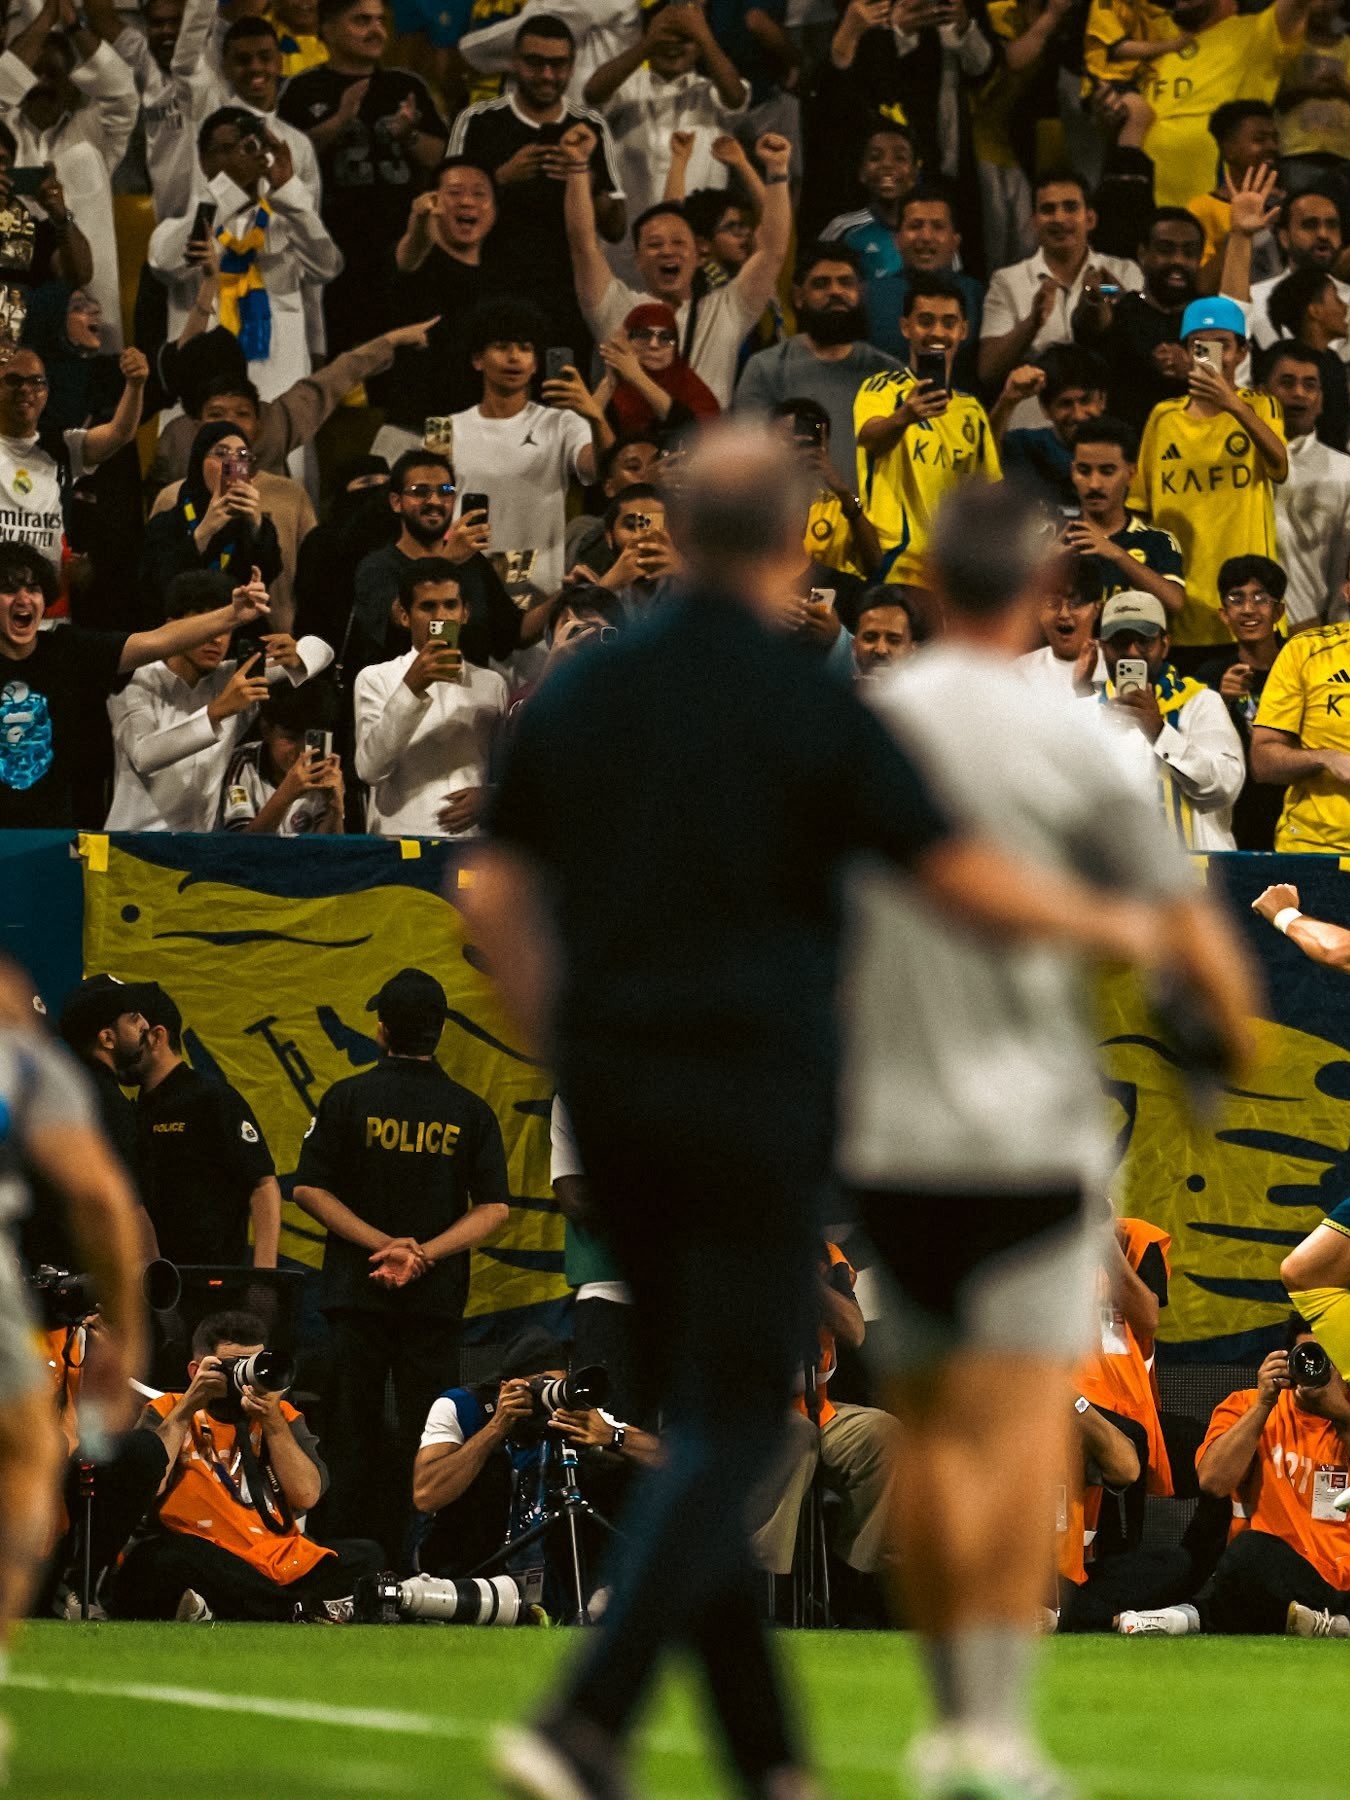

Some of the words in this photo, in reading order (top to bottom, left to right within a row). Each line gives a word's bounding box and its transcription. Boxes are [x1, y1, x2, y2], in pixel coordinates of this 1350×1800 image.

[1161, 464, 1251, 495] KAFD
[153, 1122, 186, 1134] POLICE
[366, 1117, 460, 1156] POLICE
[1271, 1443, 1312, 1494] 127
